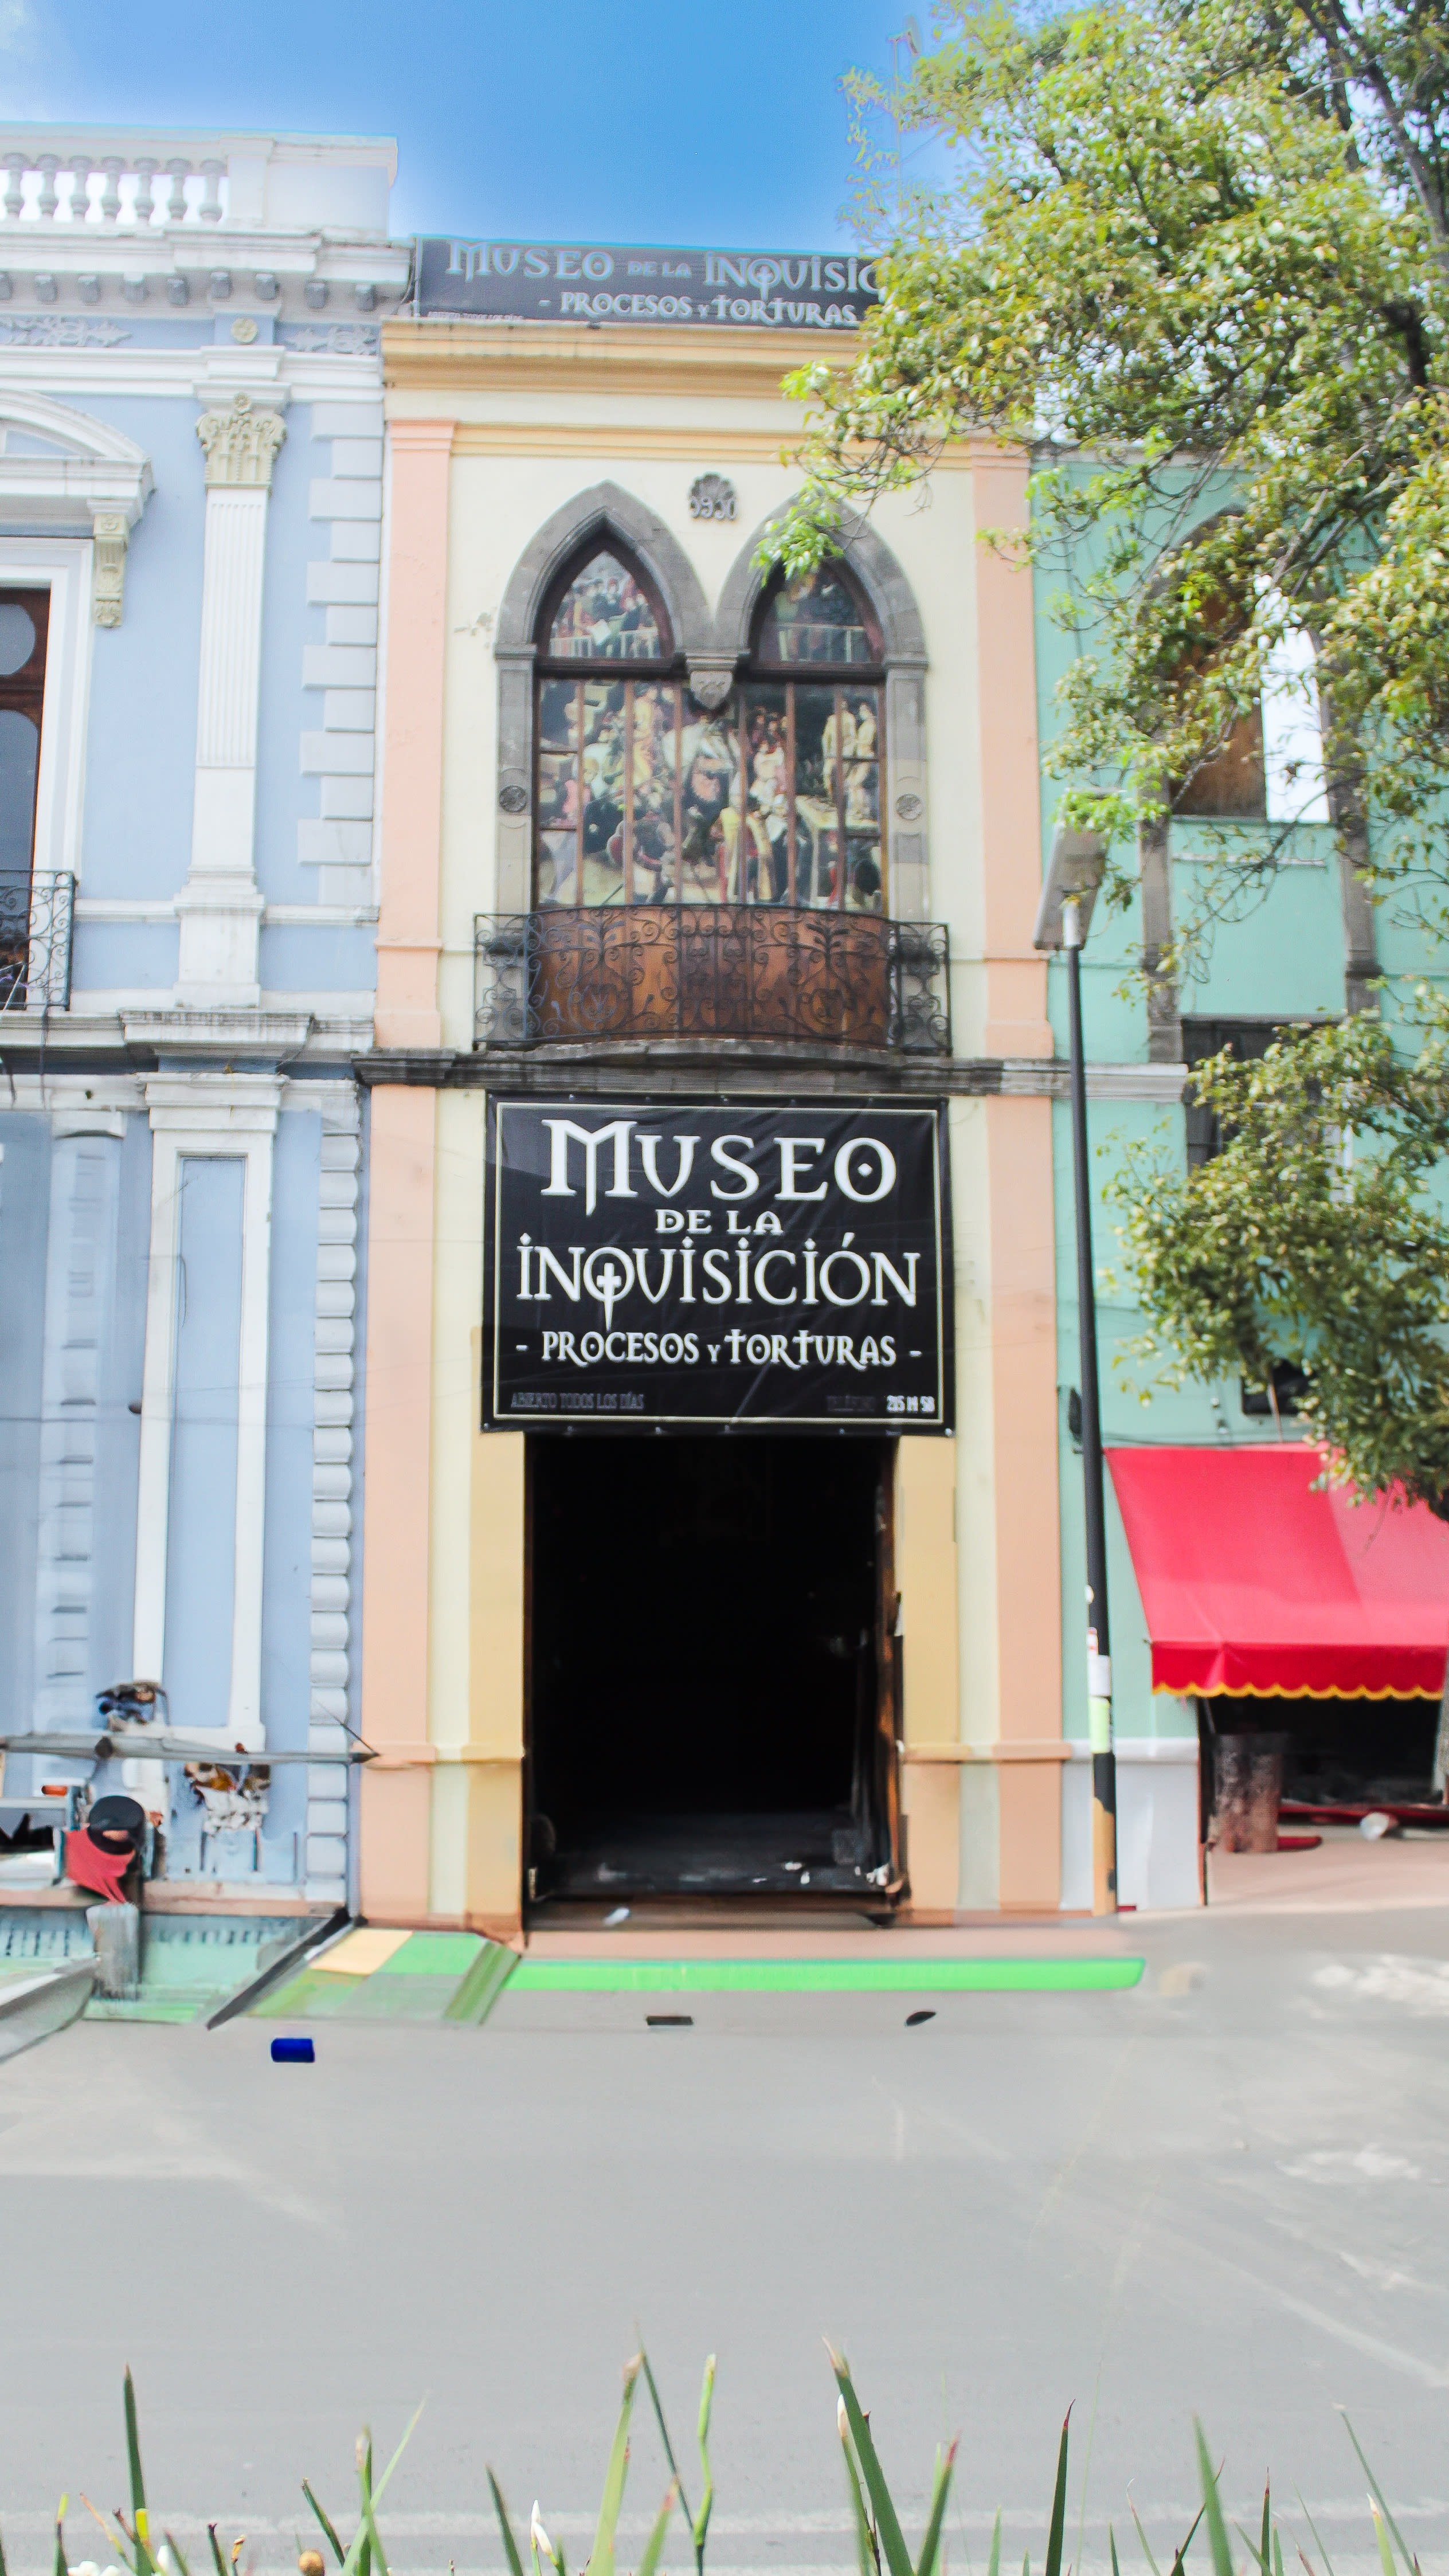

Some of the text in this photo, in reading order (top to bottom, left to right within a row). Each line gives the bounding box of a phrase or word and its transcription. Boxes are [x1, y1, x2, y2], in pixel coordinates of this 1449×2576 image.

[445, 239, 879, 302] MUSEO DE LA INQUISIC
[560, 291, 693, 319] PROCESOS
[711, 293, 860, 329] TORTURAS
[540, 1118, 897, 1216] MUSEO
[655, 1208, 785, 1236] DE LA
[541, 1330, 700, 1368] PROCESOS
[723, 1328, 897, 1372] TORTURAS
